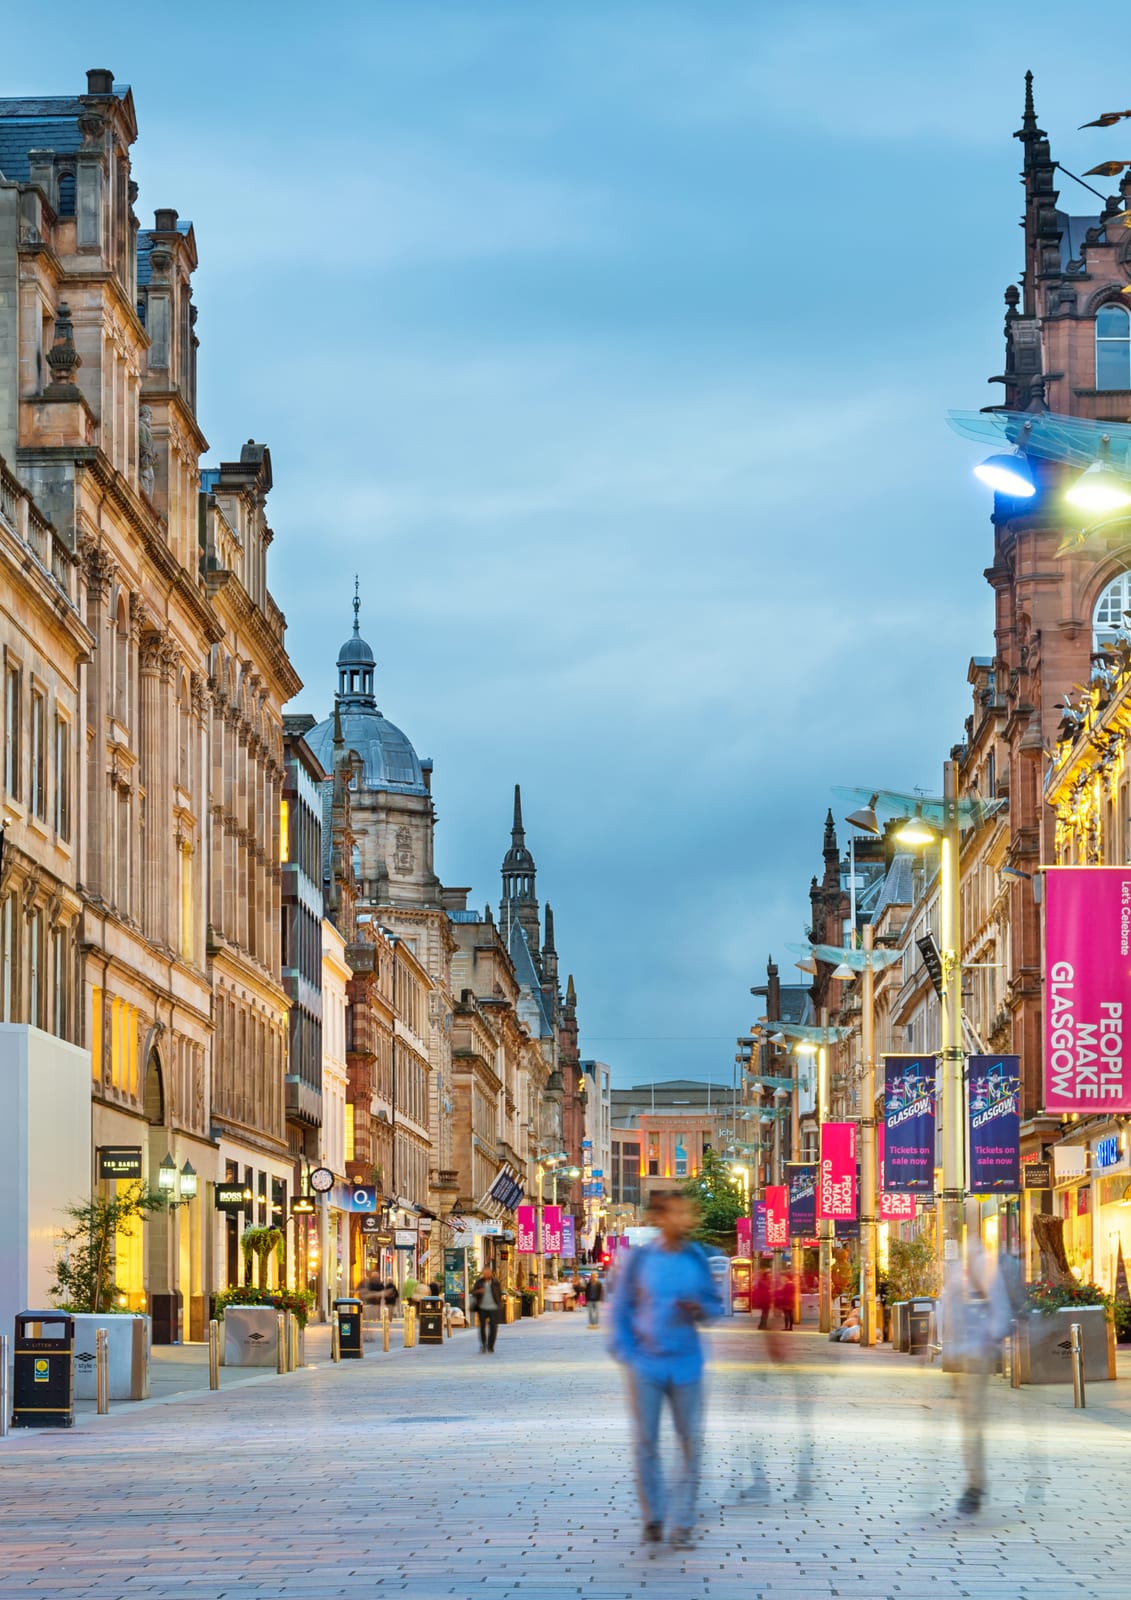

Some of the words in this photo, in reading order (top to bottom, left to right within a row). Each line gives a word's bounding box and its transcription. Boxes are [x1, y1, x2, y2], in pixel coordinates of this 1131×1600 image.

[1121, 881, 1131, 905] Let's
[1121, 906, 1131, 956] Celebrate
[1050, 961, 1075, 1098] GLASGOW
[1075, 1022, 1098, 1098] MAKE
[1100, 1002, 1123, 1098] PEOPLE
[888, 1097, 930, 1128] GLASGOW
[972, 1096, 1014, 1128] GLASGOW
[889, 1146, 918, 1154] Tickets
[891, 1157, 908, 1165] sale
[975, 1146, 1003, 1154] Tickets
[977, 1157, 994, 1165] sale
[822, 1159, 833, 1214] GLASGOW
[832, 1183, 842, 1214] MAKE
[842, 1175, 852, 1214] PEOPLE
